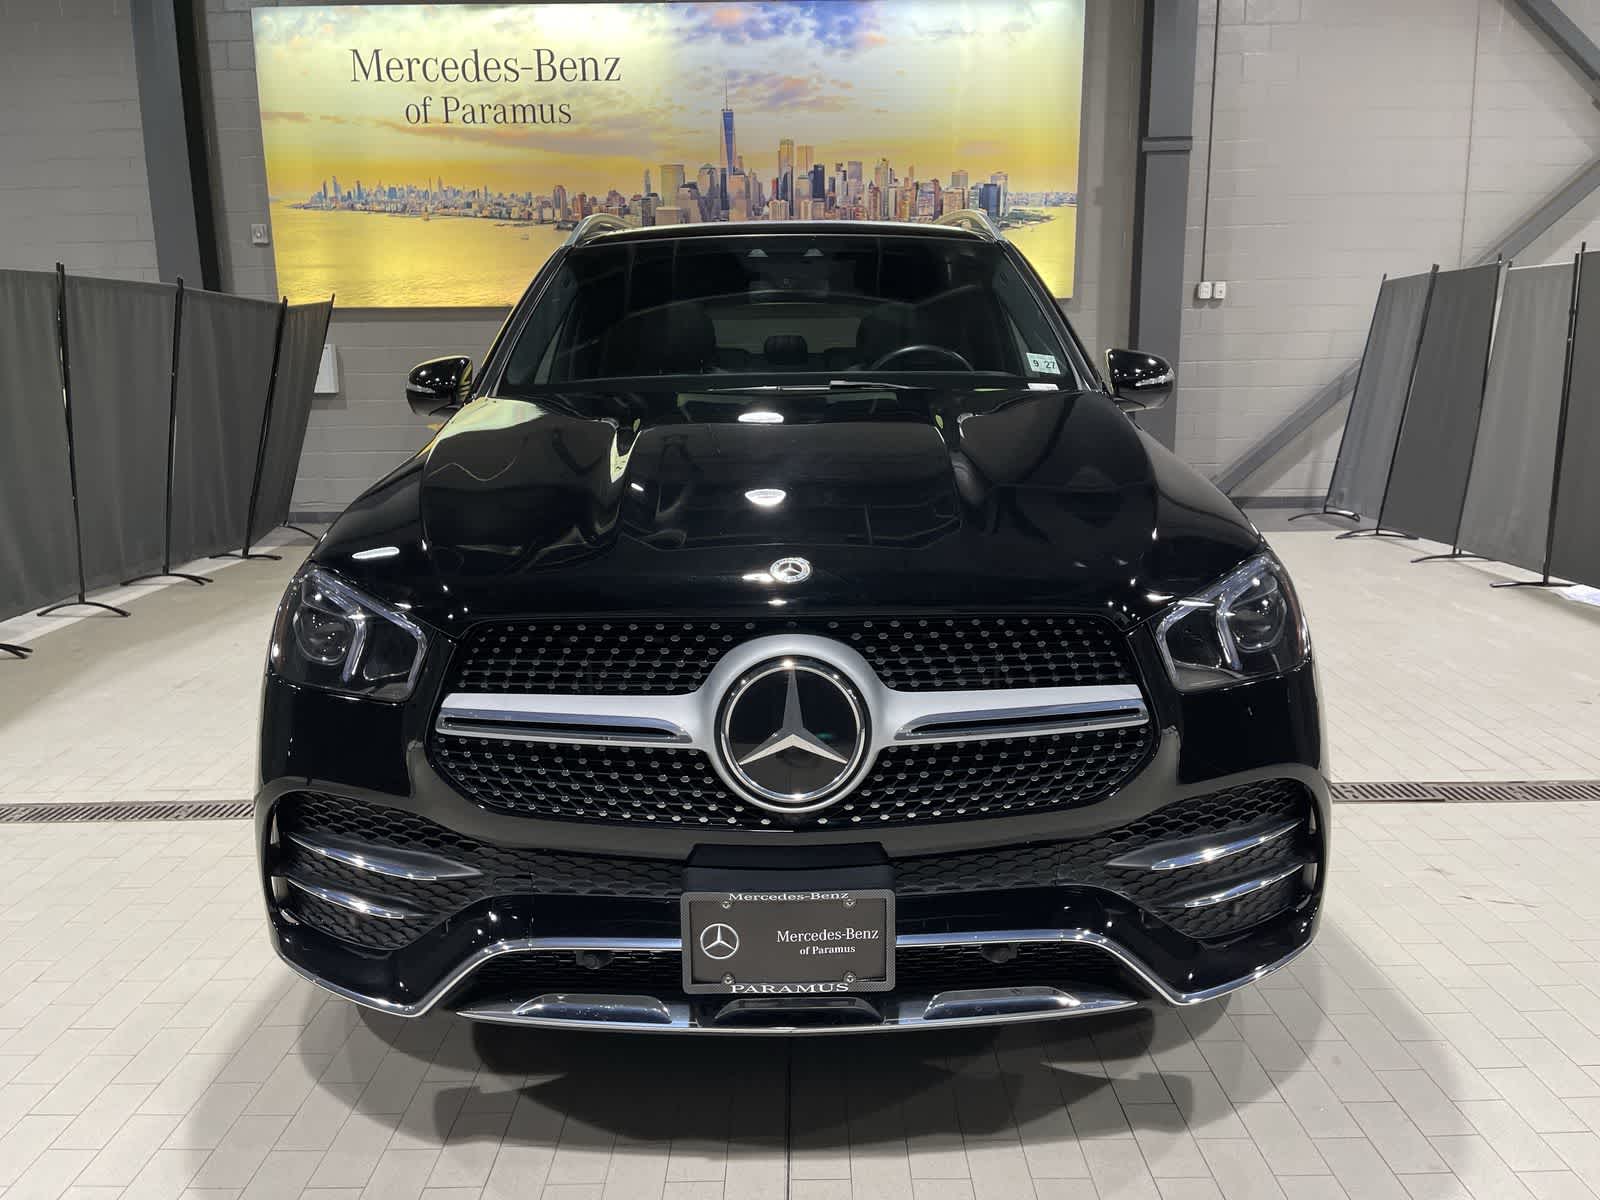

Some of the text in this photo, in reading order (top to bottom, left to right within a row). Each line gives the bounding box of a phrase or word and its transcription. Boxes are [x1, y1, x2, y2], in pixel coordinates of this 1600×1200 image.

[350, 48, 621, 83] Mercedes-Benz
[405, 95, 572, 125] of Paramus
[729, 892, 849, 901] Mercedes-Benz
[776, 928, 879, 943] Mercedes-Benz
[800, 945, 856, 955] of Paramus
[730, 983, 849, 994] PARAMUS
